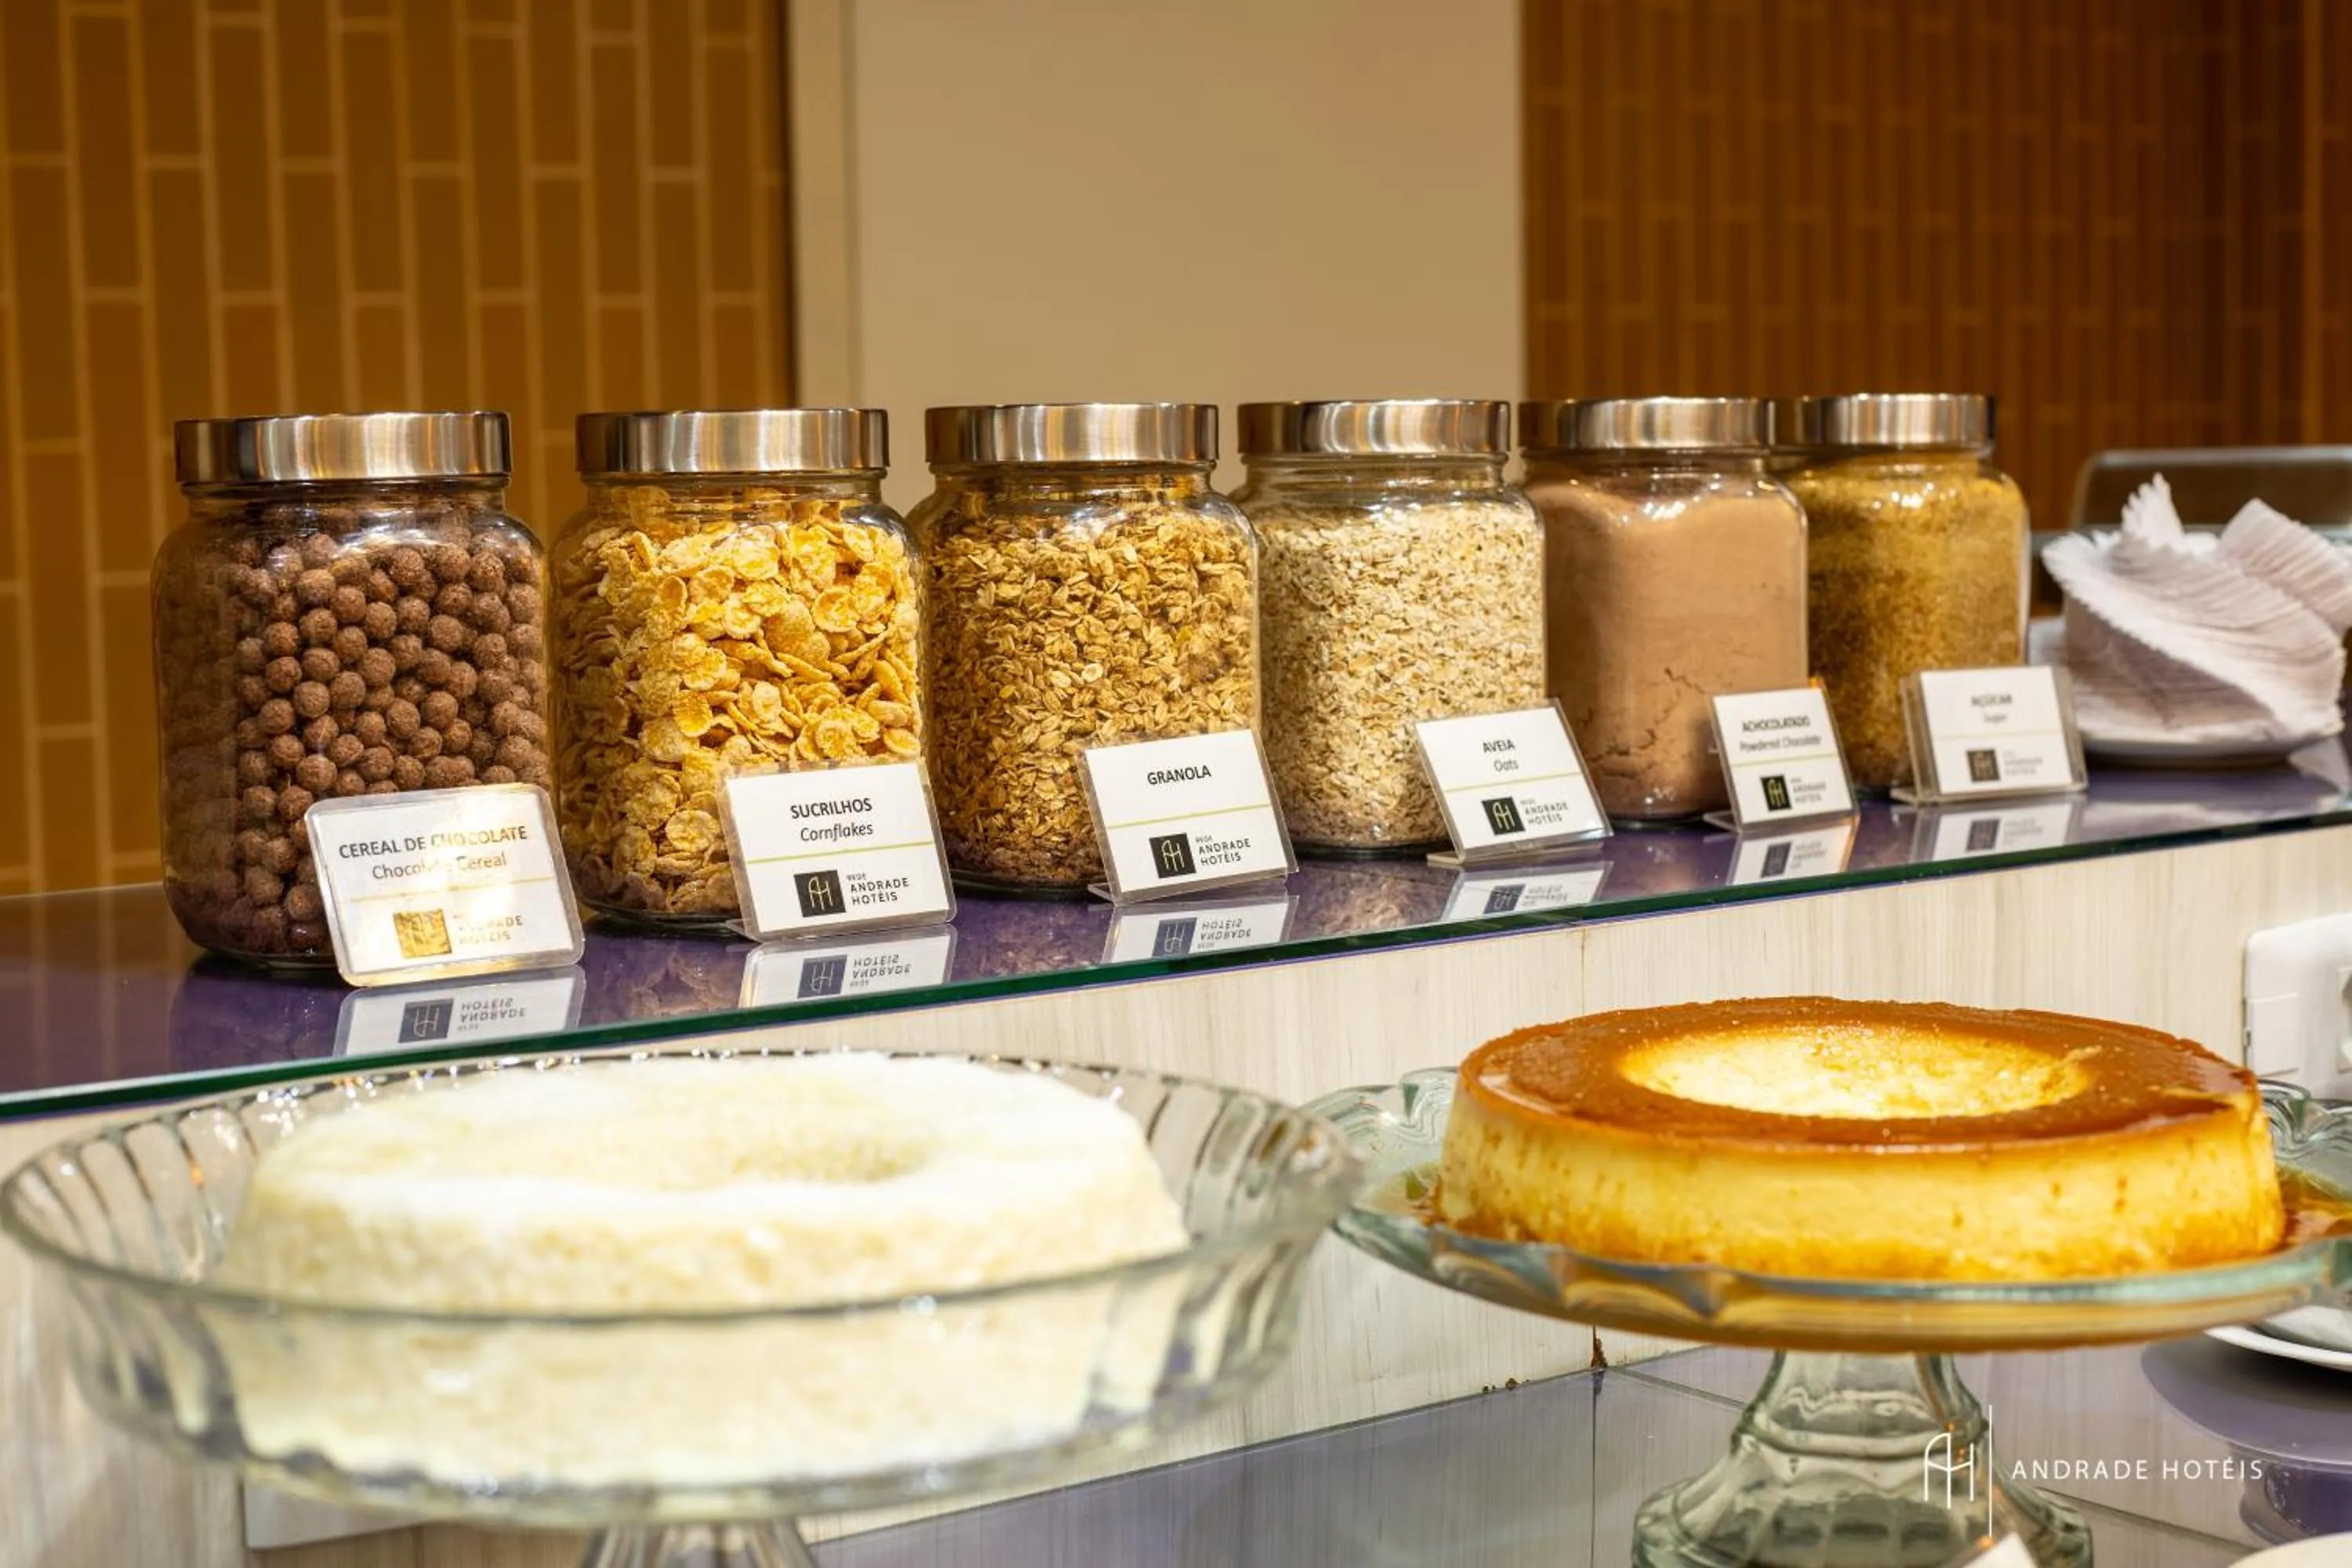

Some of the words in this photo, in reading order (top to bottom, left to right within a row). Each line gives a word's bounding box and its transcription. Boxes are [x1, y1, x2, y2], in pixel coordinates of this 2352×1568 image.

[1483, 739, 1515, 753] AVEIA
[1147, 764, 1211, 786] GRANOLA
[1494, 760, 1519, 772] Oats
[790, 797, 873, 818] SUCRILHOS
[800, 822, 873, 842] Cornflakes
[339, 840, 401, 859] CEREAL
[406, 837, 426, 851] DE
[1199, 838, 1251, 855] ANDRADE
[456, 851, 507, 871] Cereal
[851, 878, 909, 892] ANDRADE
